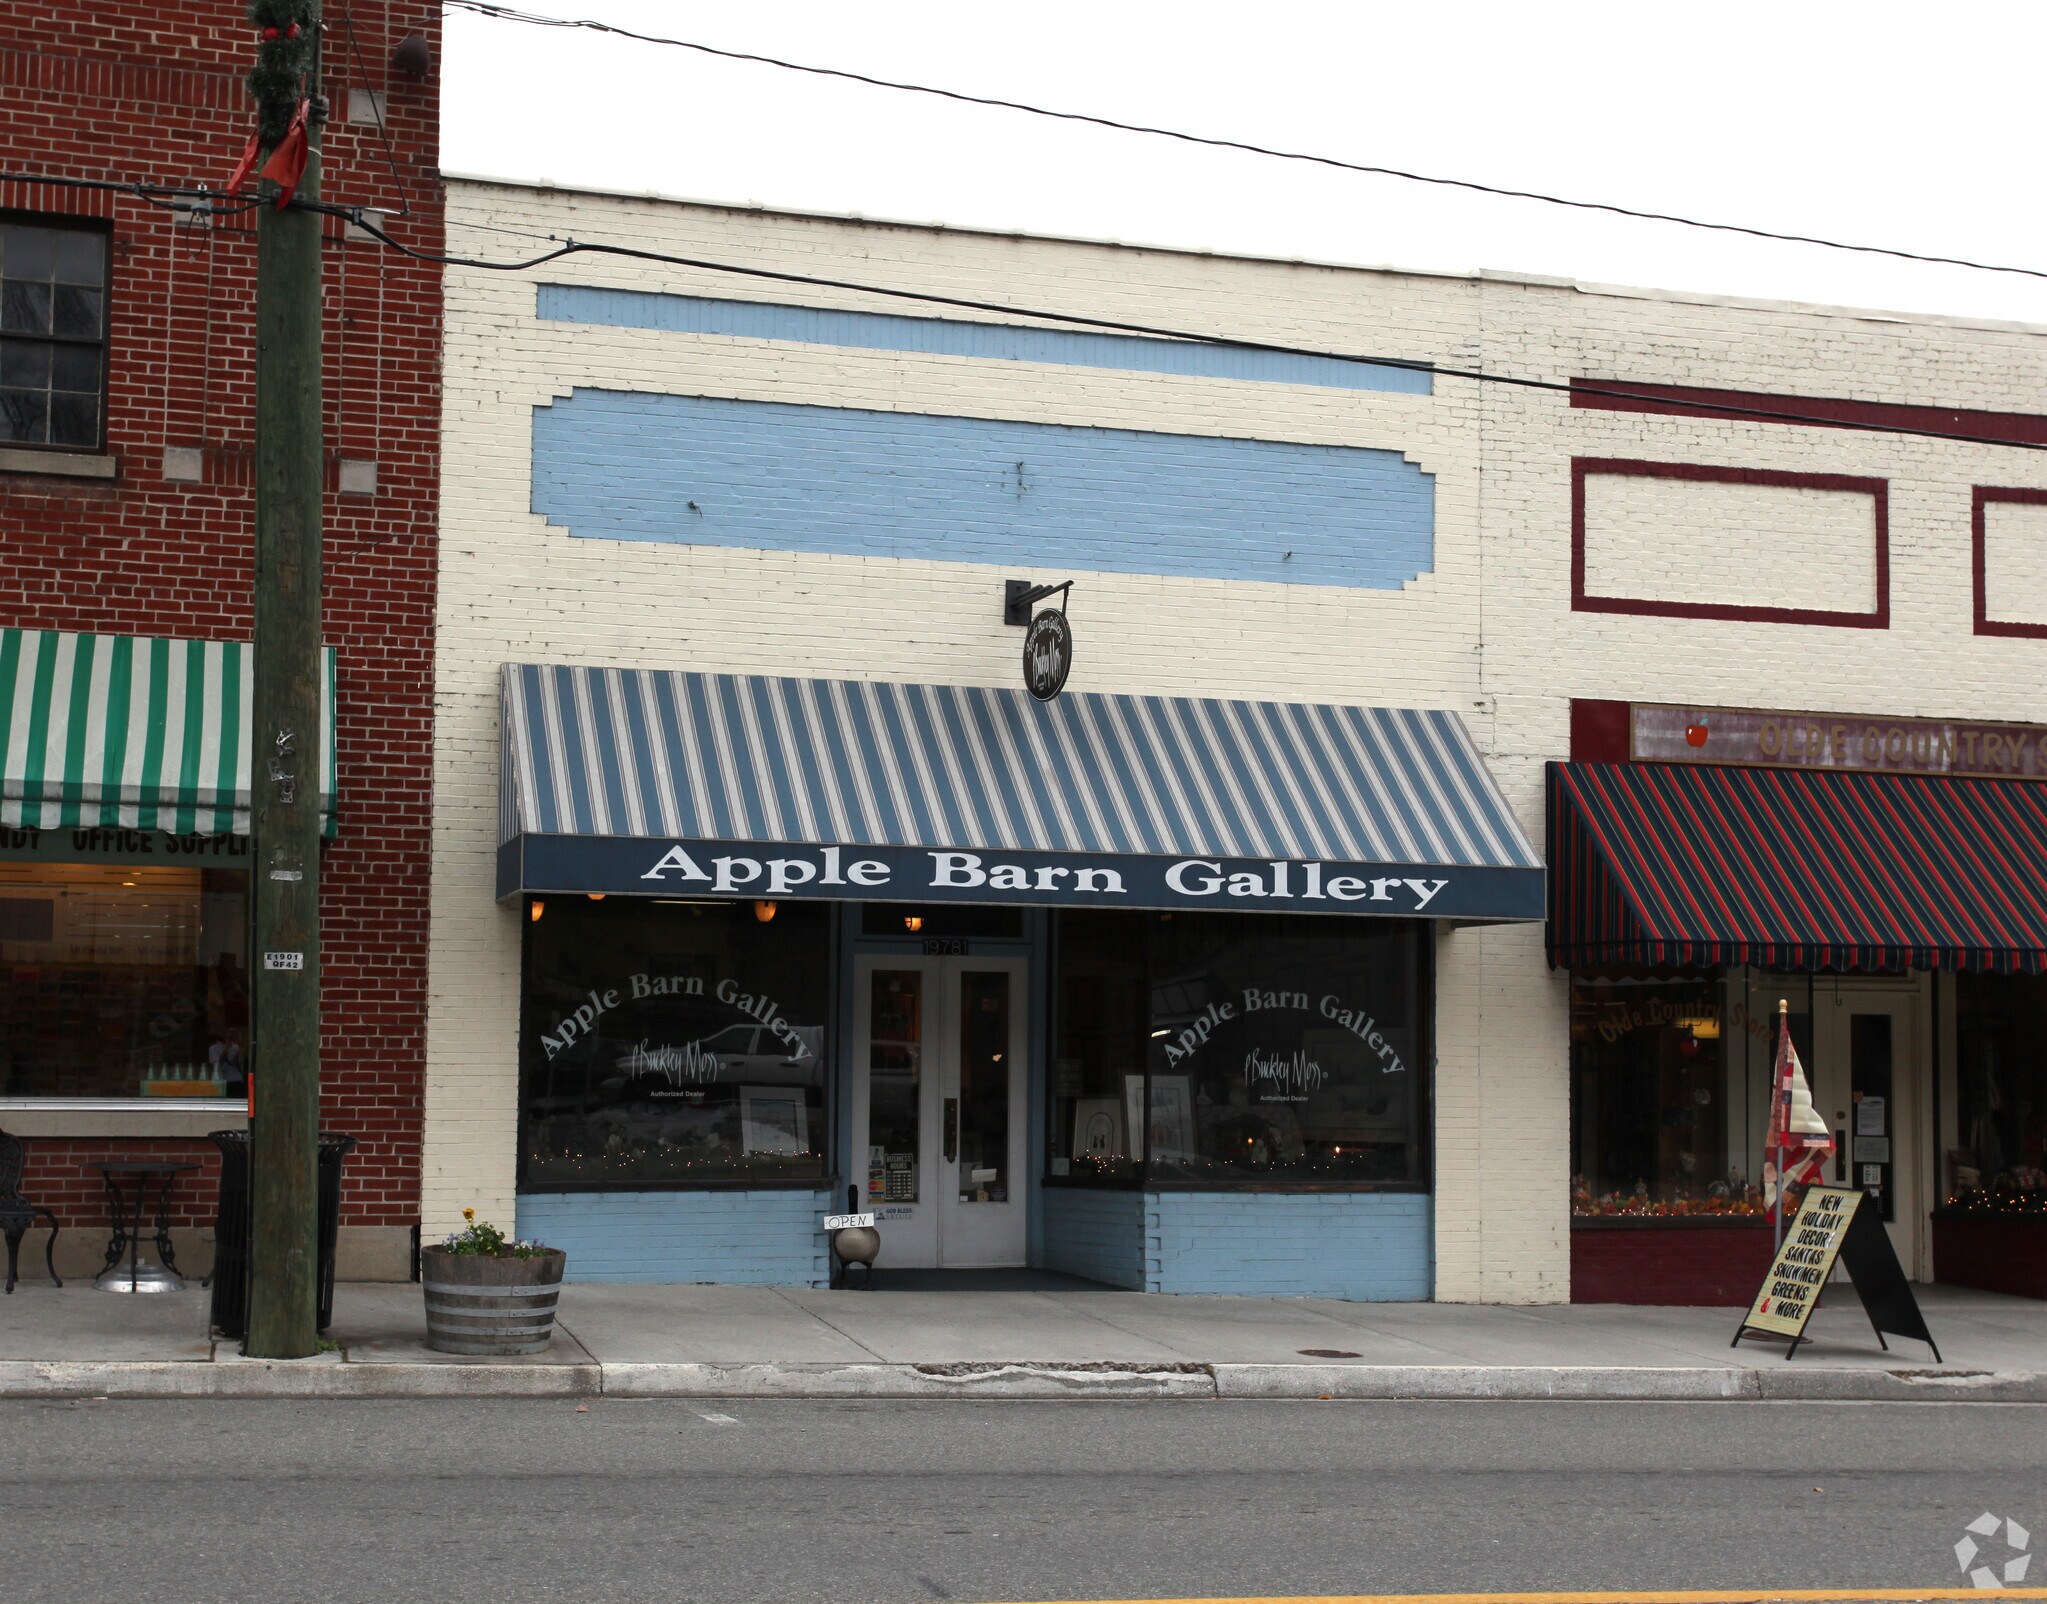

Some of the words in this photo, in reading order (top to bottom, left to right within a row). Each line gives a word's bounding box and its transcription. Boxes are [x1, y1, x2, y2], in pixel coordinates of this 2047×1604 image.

[1758, 719, 1846, 760] OLDE
[1862, 725, 2028, 769] COUNTRY
[640, 844, 891, 894] Apple
[928, 851, 1128, 894] Barn
[1165, 859, 1450, 910] Gallery
[266, 953, 299, 961] E1901
[924, 940, 967, 955] 19781
[272, 960, 298, 969] QF42
[540, 989, 621, 1061] Apple
[628, 973, 705, 999] Barn
[716, 978, 813, 1062] Gallery
[1598, 1005, 1643, 1043] Olde
[1649, 997, 1722, 1028] Country
[1164, 1002, 1236, 1069] Apple
[1241, 988, 1310, 1012] Barn
[1319, 995, 1405, 1074] Gallery
[650, 1090, 684, 1098] Authorized
[685, 1090, 705, 1098] Dealer
[886, 1155, 912, 1163] BUSINESS
[889, 1162, 908, 1170] HOURS
[1818, 1194, 1844, 1212] NEW
[828, 1215, 867, 1229] OPEN
[1800, 1210, 1845, 1230] HOLIDAY
[1797, 1228, 1831, 1248] DECOR
[1785, 1246, 1825, 1265] SANTAS
[1773, 1262, 1825, 1286] SNOWMEN
[1771, 1280, 1809, 1302] GREENS
[1775, 1300, 1806, 1320] MORE
